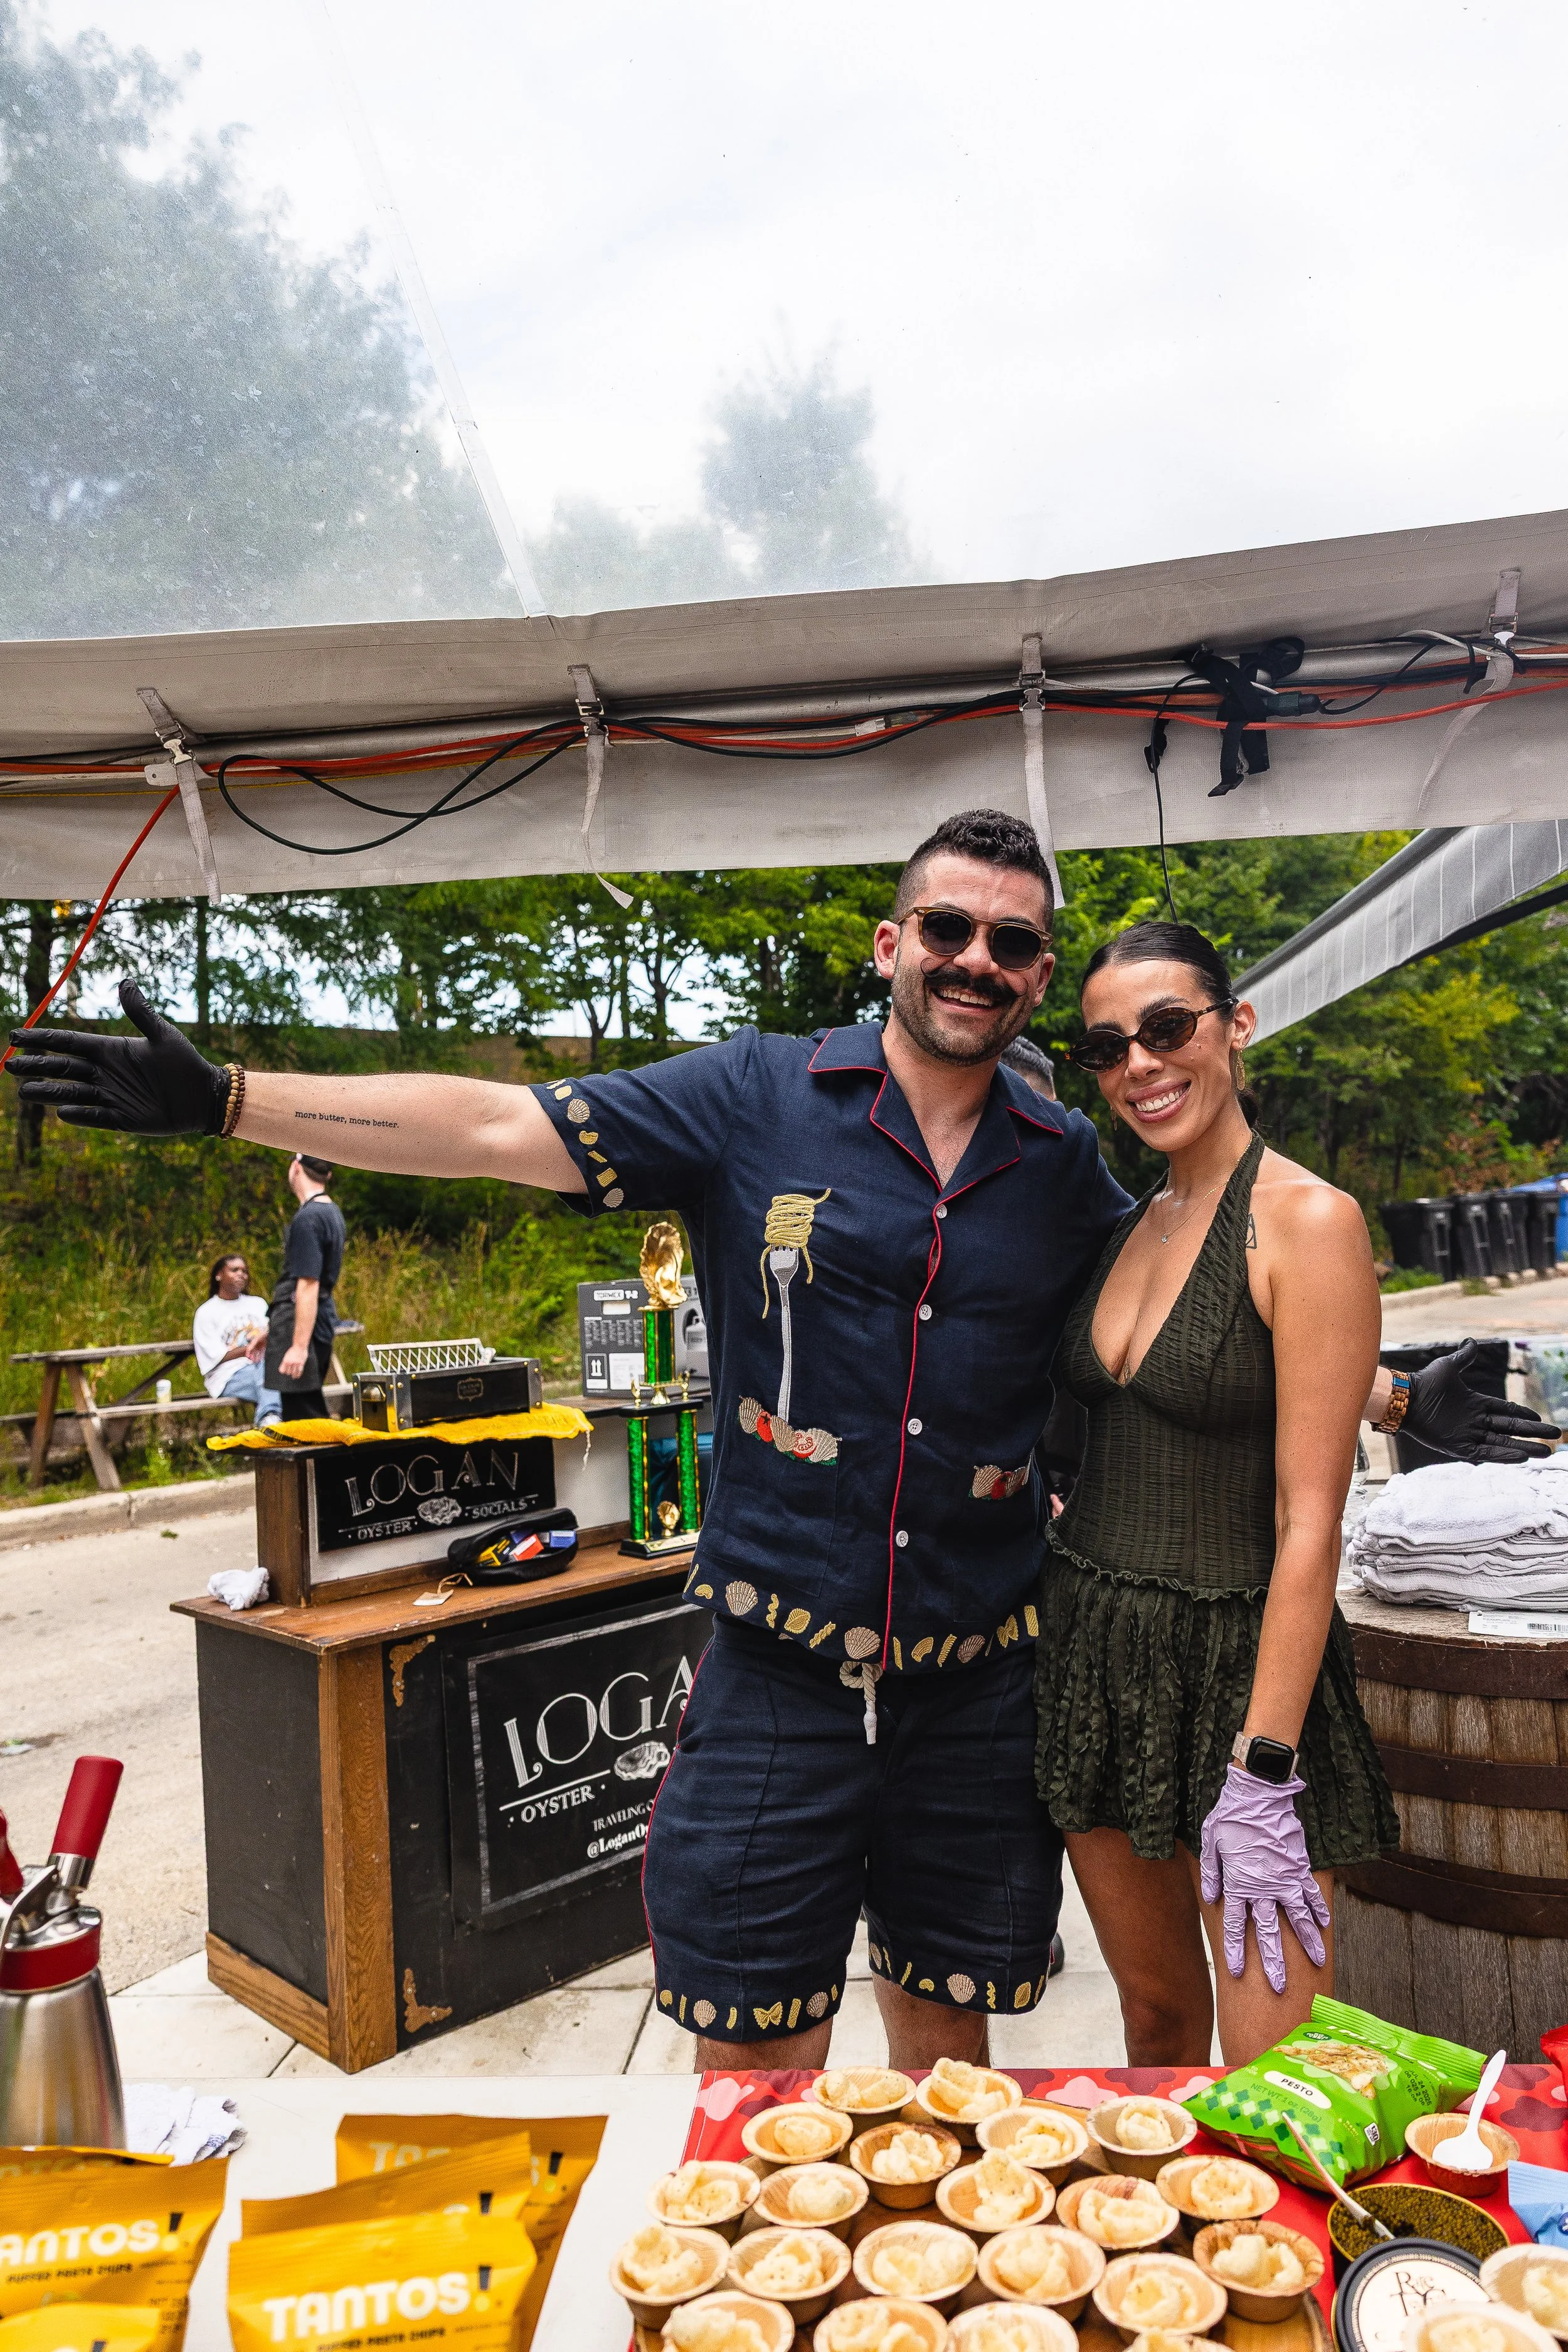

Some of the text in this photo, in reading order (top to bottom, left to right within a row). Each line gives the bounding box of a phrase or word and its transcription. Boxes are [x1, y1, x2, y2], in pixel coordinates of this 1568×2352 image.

[295, 1111, 400, 1128] more butter, more better.
[344, 1449, 519, 1517] LOGAN
[357, 1498, 528, 1540] OYSTER SOCIALS
[504, 1655, 692, 1788] LOGA
[521, 1784, 595, 1823] OYSTER
[1281, 2078, 1314, 2096] PESTO
[0, 2212, 184, 2266] ANTOS!
